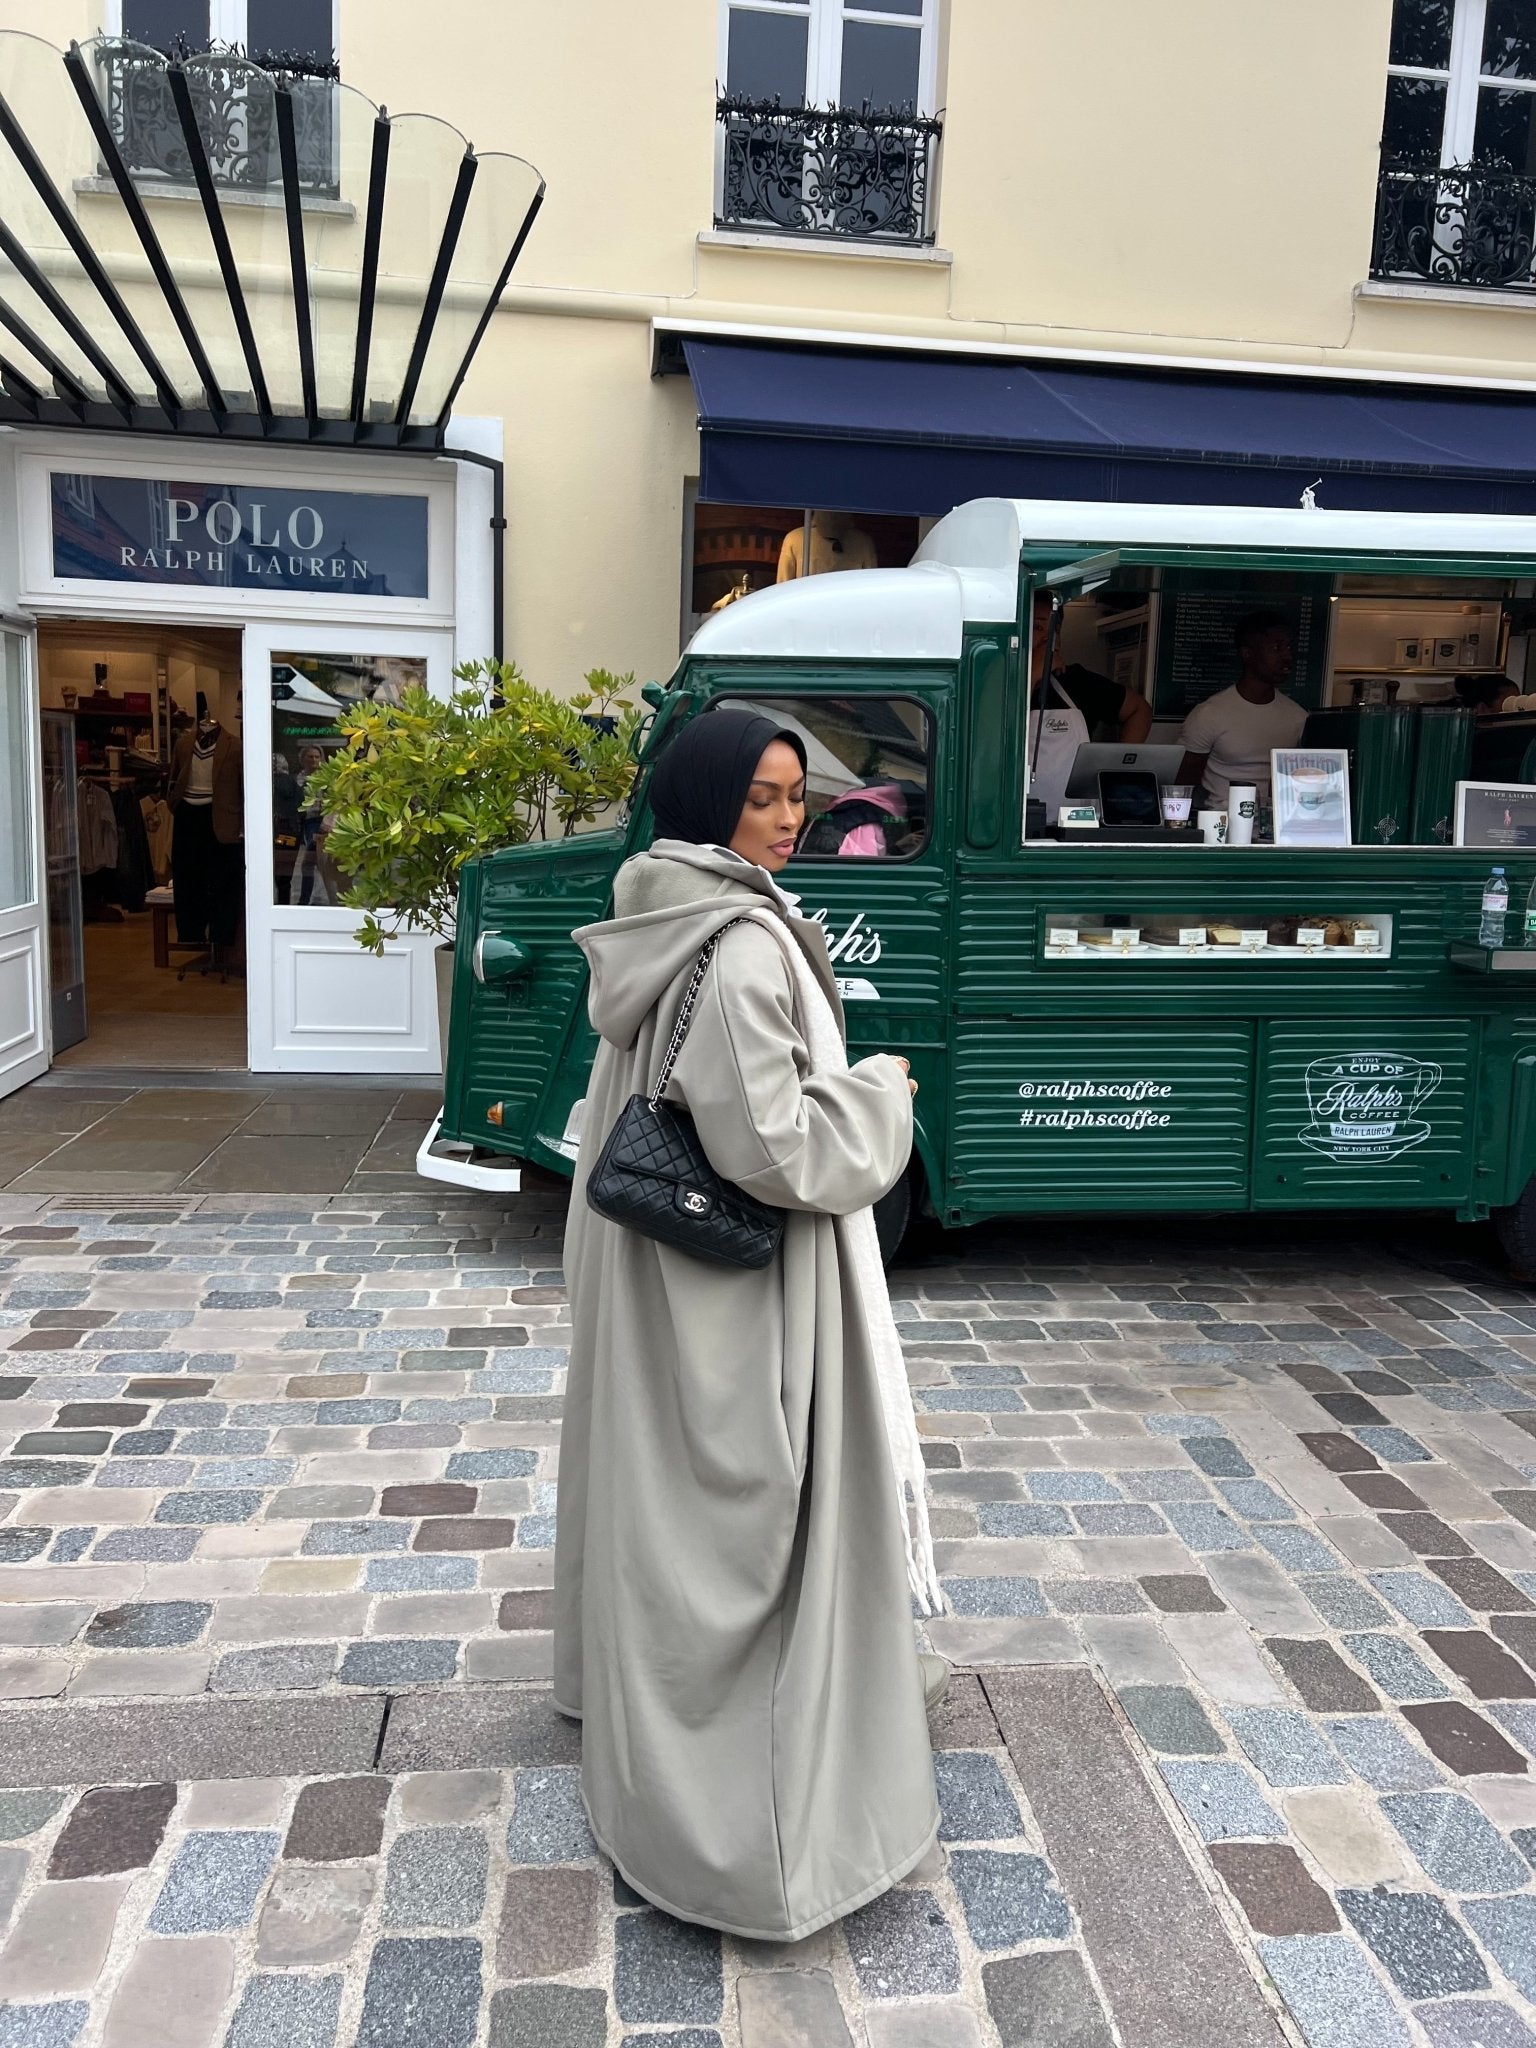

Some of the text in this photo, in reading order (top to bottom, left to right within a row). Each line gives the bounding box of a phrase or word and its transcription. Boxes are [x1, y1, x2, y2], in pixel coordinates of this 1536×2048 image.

[164, 498, 324, 550] POLO
[120, 546, 369, 580] RALPH LAUREN
[1331, 1064, 1405, 1075] A CUP OF
[1018, 1080, 1172, 1101] @ralphscoffee
[1316, 1081, 1403, 1124] Ralph's
[1019, 1109, 1171, 1130] #ralphscoffee
[1349, 1111, 1400, 1119] COFFEE
[1334, 1126, 1392, 1137] RALPH LAUREN
